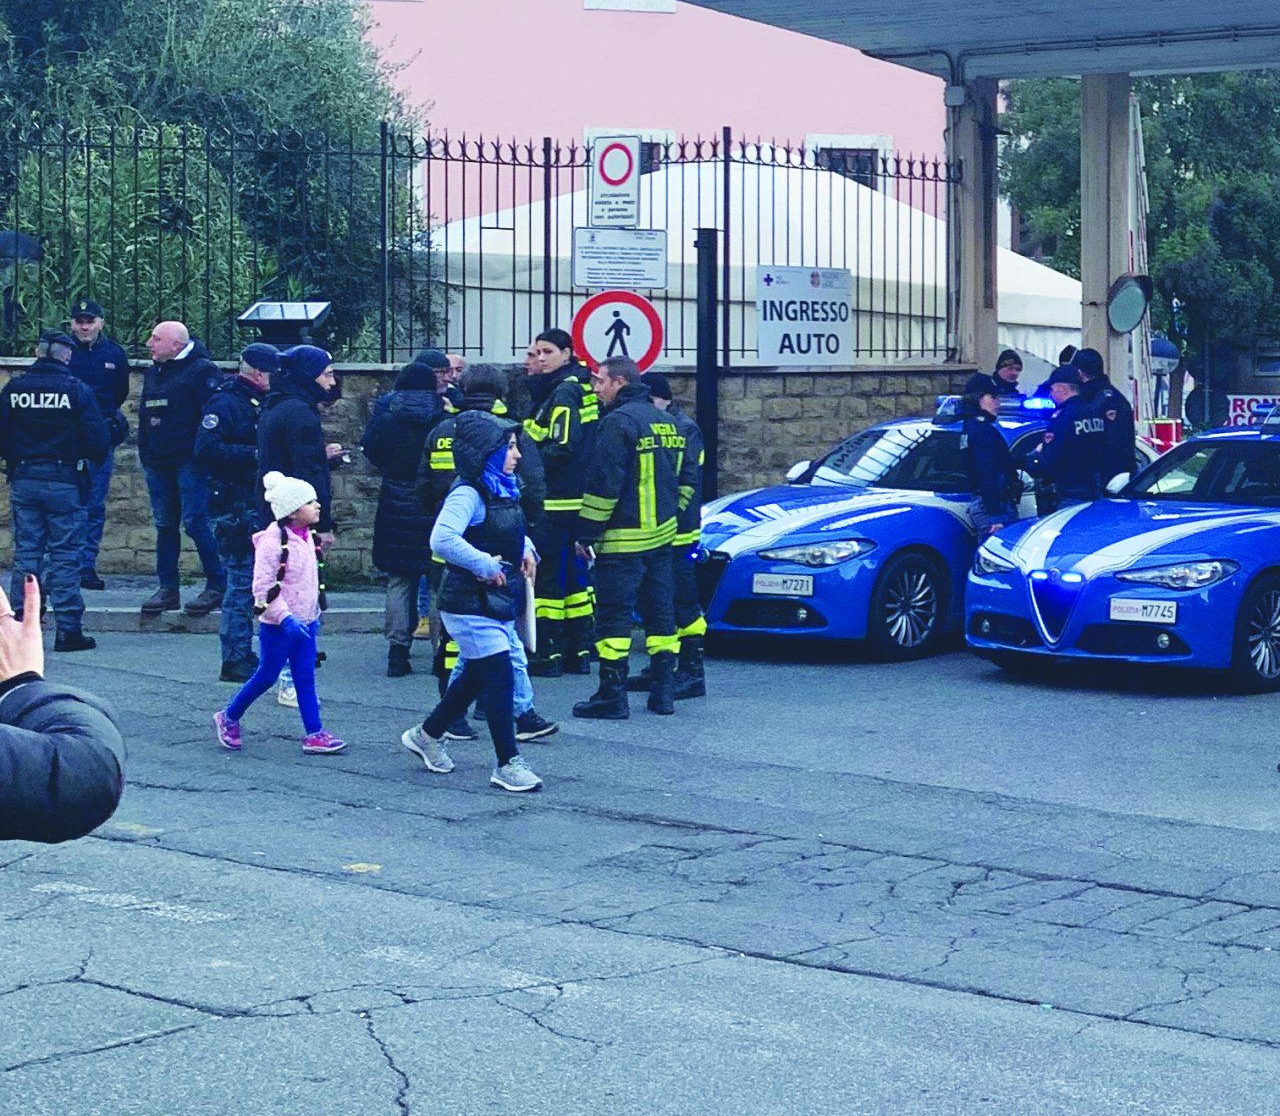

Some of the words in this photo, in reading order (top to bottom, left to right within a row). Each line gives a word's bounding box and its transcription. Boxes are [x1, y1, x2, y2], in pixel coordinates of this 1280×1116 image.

[762, 299, 849, 323] INGRESSO
[778, 333, 840, 355] AUTO
[10, 393, 71, 410] POLIZIA
[1074, 418, 1105, 435] POLIZI
[436, 437, 454, 450] DE
[1141, 604, 1174, 619] M7745
